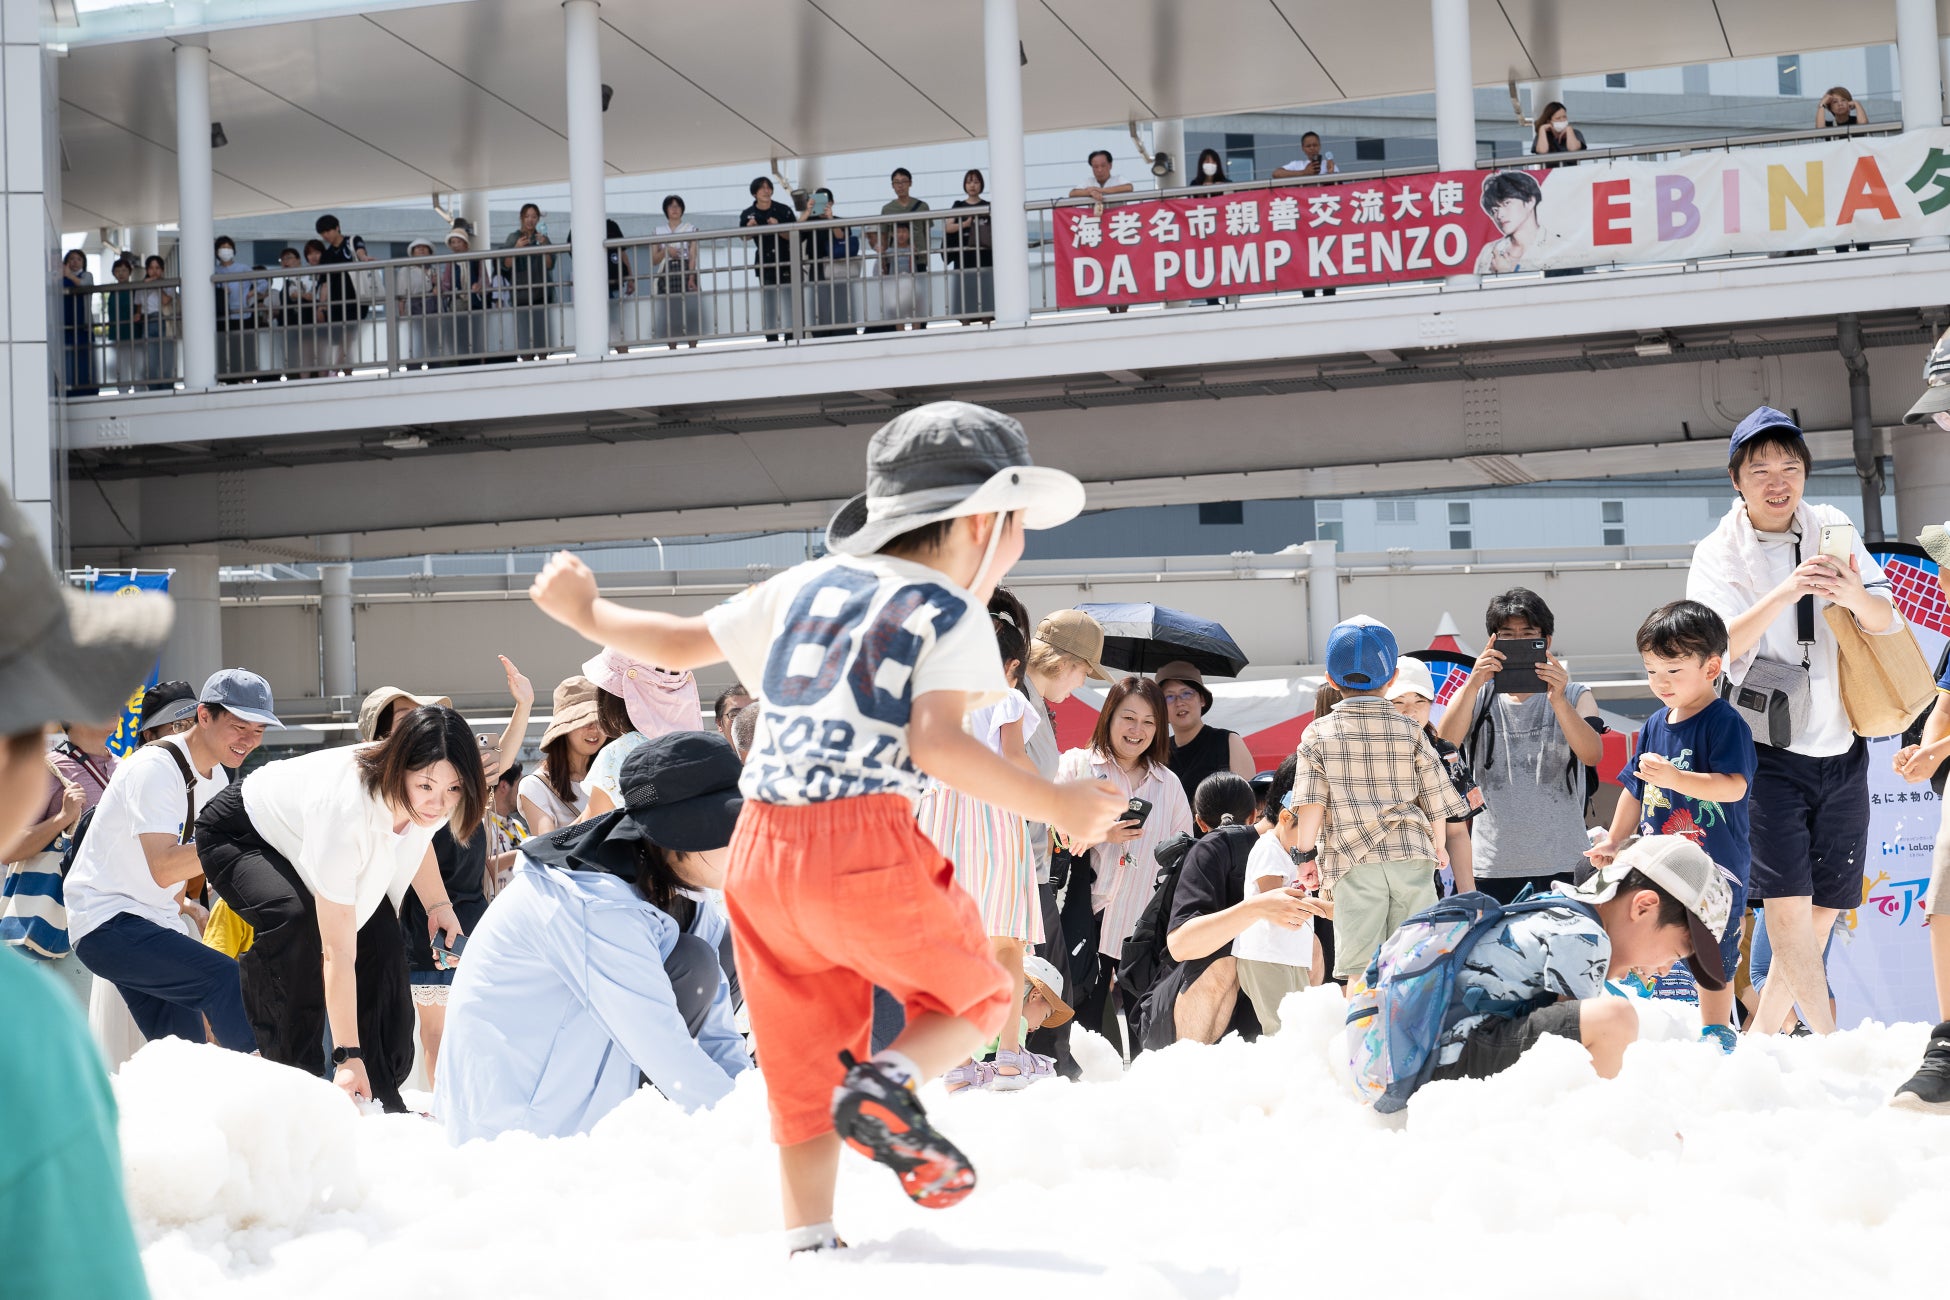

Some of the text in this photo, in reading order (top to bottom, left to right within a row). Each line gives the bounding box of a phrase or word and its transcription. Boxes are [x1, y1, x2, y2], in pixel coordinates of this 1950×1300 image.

[1070, 180, 1465, 249] 海老名市親善交流大使
[1072, 223, 1468, 297] DA PUMP KENZO
[1869, 877, 1931, 927] でア
